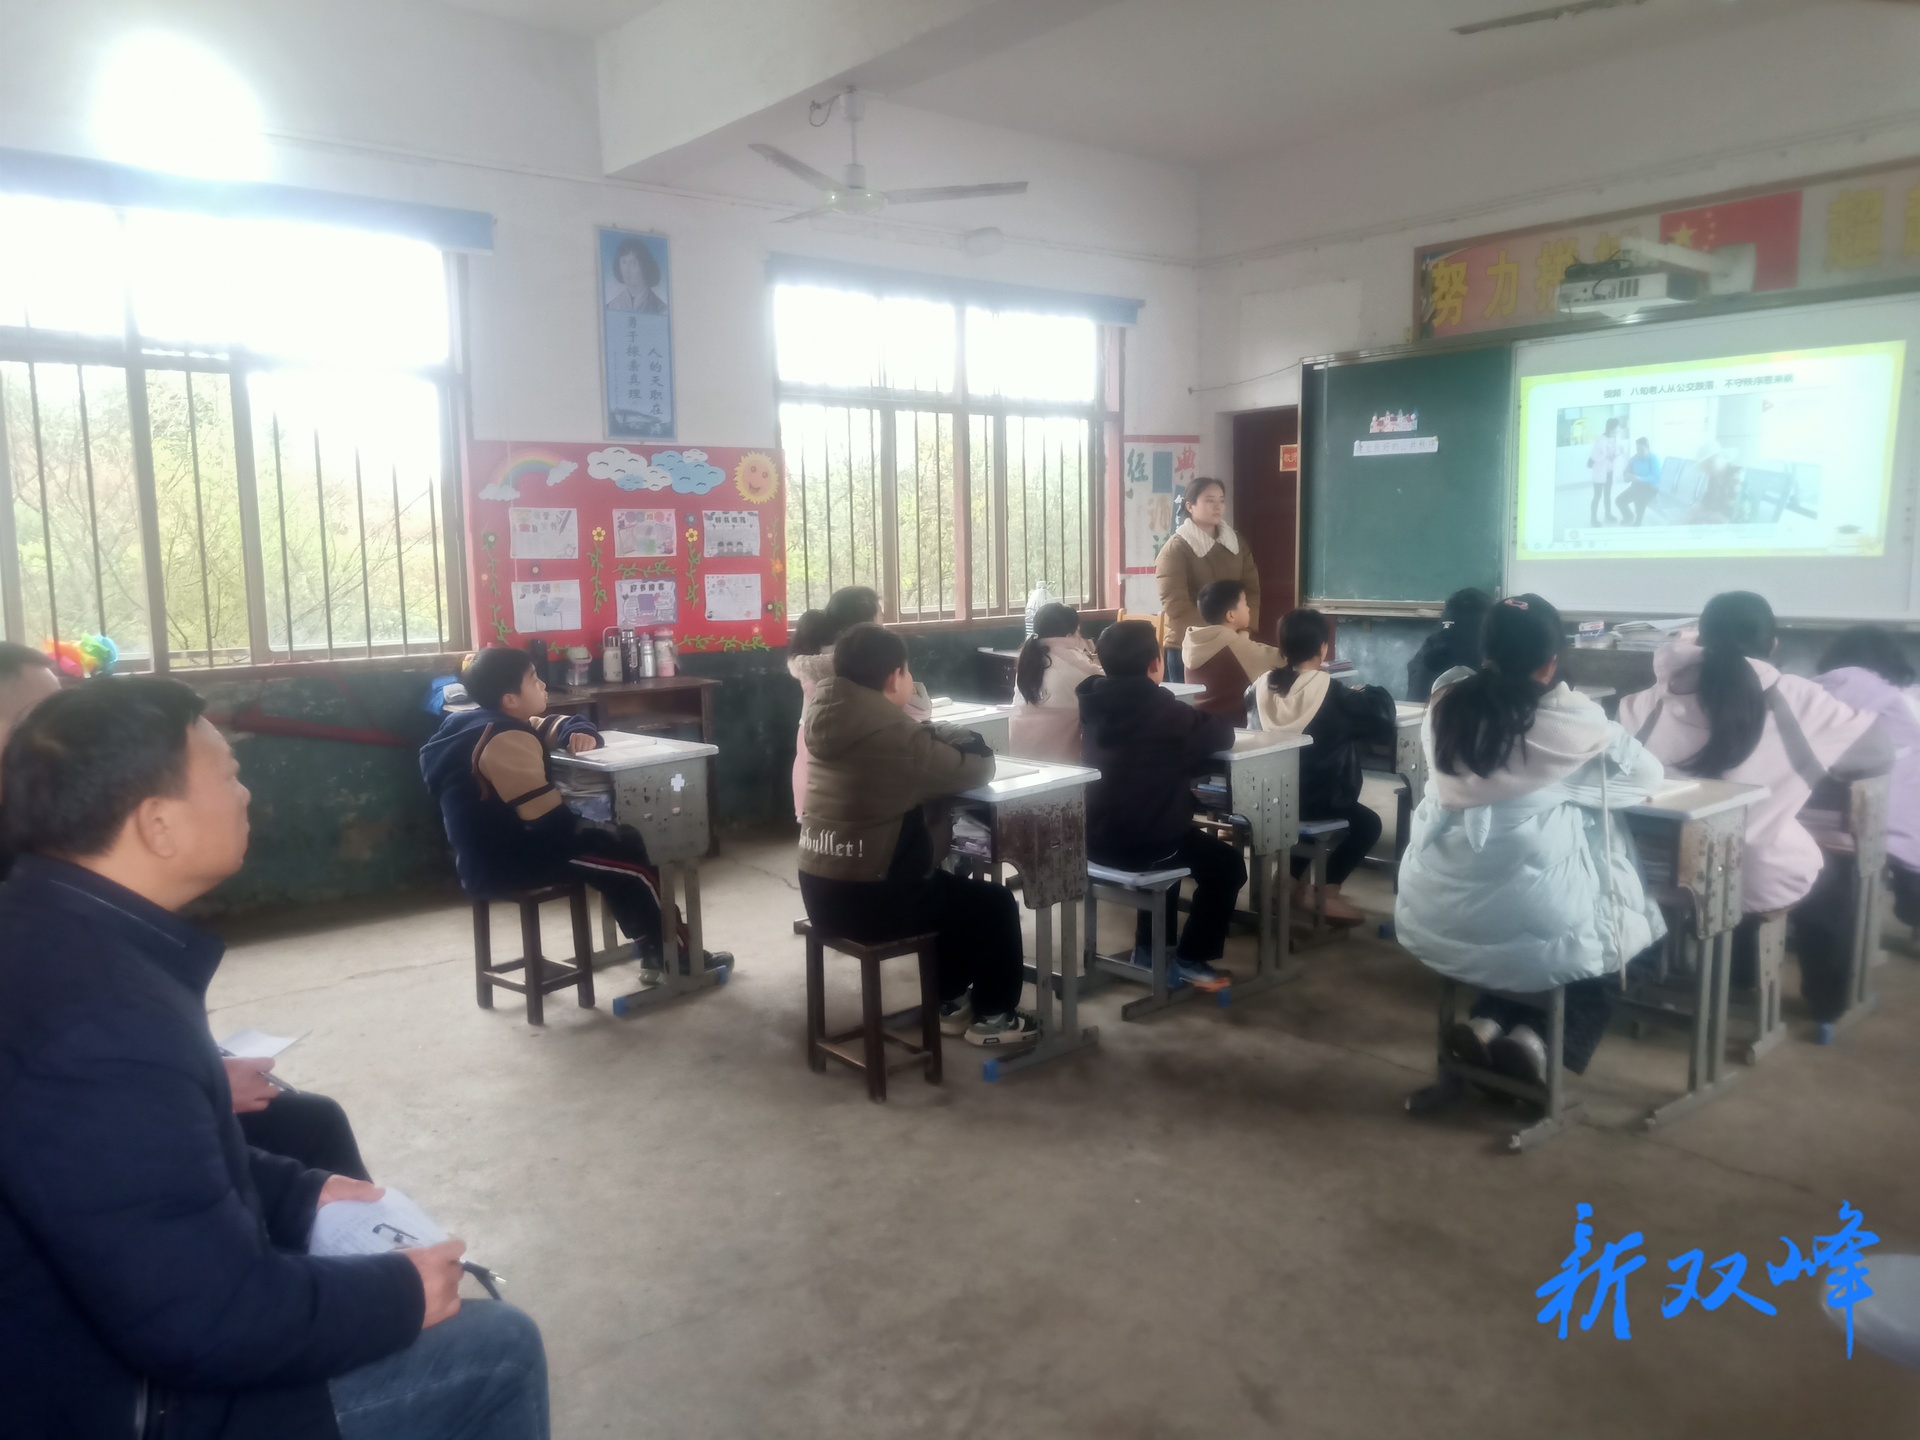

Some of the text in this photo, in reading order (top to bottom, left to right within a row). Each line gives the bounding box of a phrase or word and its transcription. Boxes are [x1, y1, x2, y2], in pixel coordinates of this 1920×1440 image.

[647, 347, 664, 415] 人的天职在
